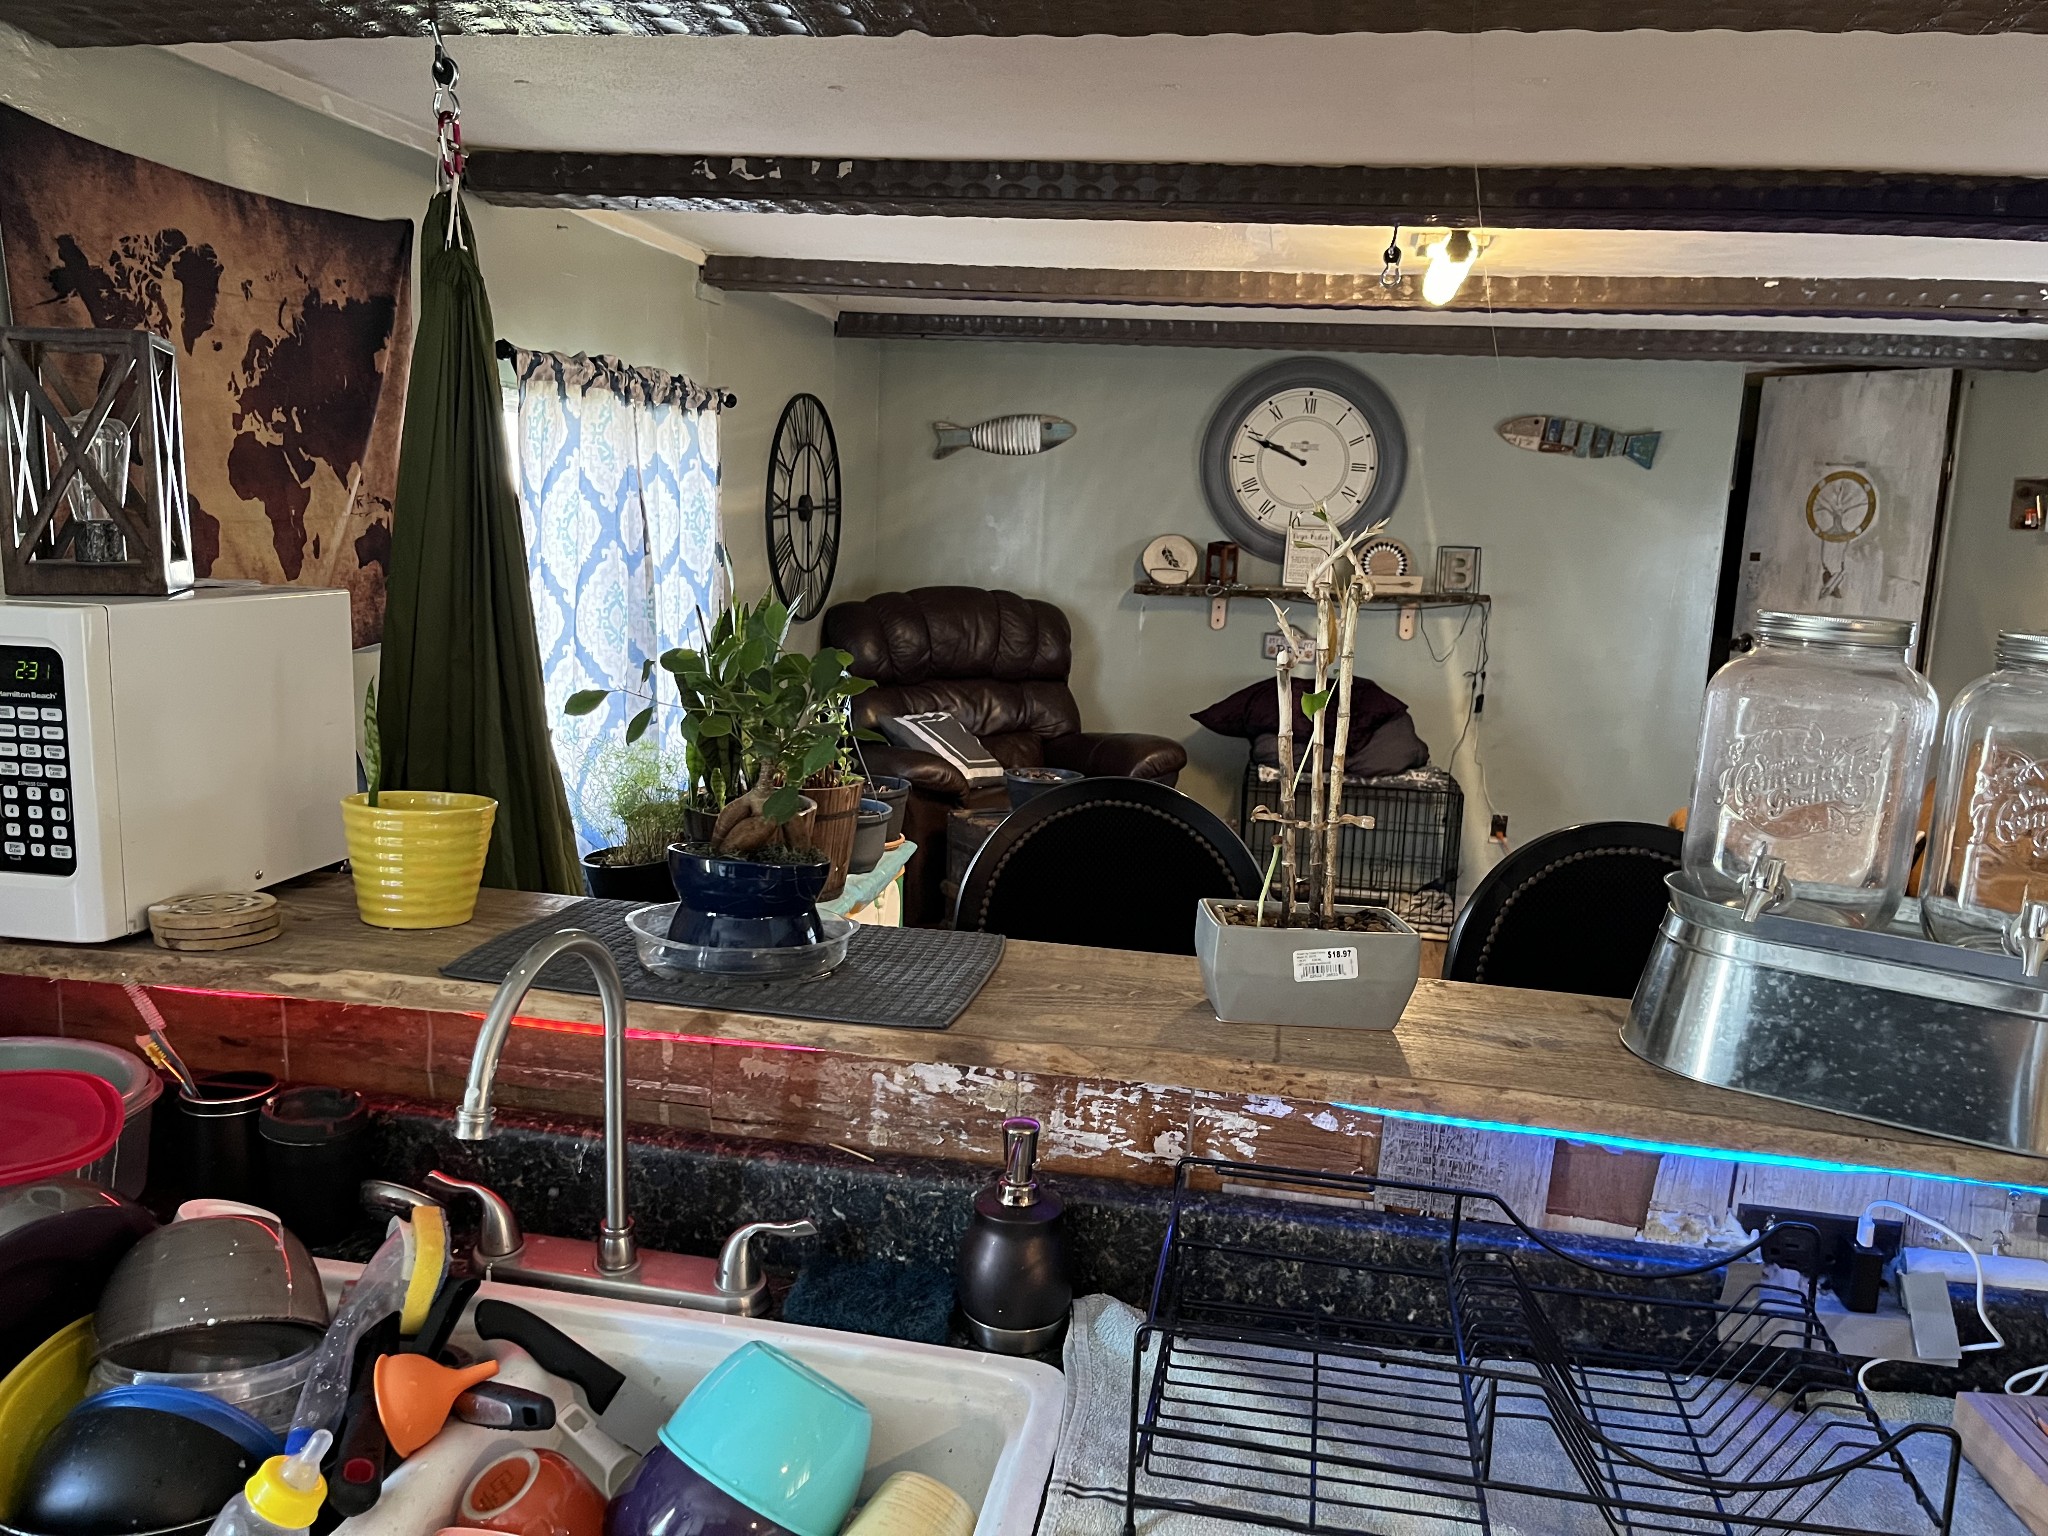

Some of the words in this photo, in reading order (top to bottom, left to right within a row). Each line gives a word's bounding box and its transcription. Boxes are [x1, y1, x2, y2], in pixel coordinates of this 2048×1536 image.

[1269, 405, 1283, 422] XI
[1303, 398, 1317, 414] XII
[1349, 436, 1365, 447] II
[1239, 453, 1256, 464] IX
[1351, 462, 1367, 472] III
[1241, 477, 1260, 499] VIII
[1341, 486, 1358, 503] IV
[1258, 499, 1276, 519] VII
[1444, 551, 1474, 589] B
[15, 660, 51, 680] 2:31
[1327, 949, 1351, 959] $18.97
